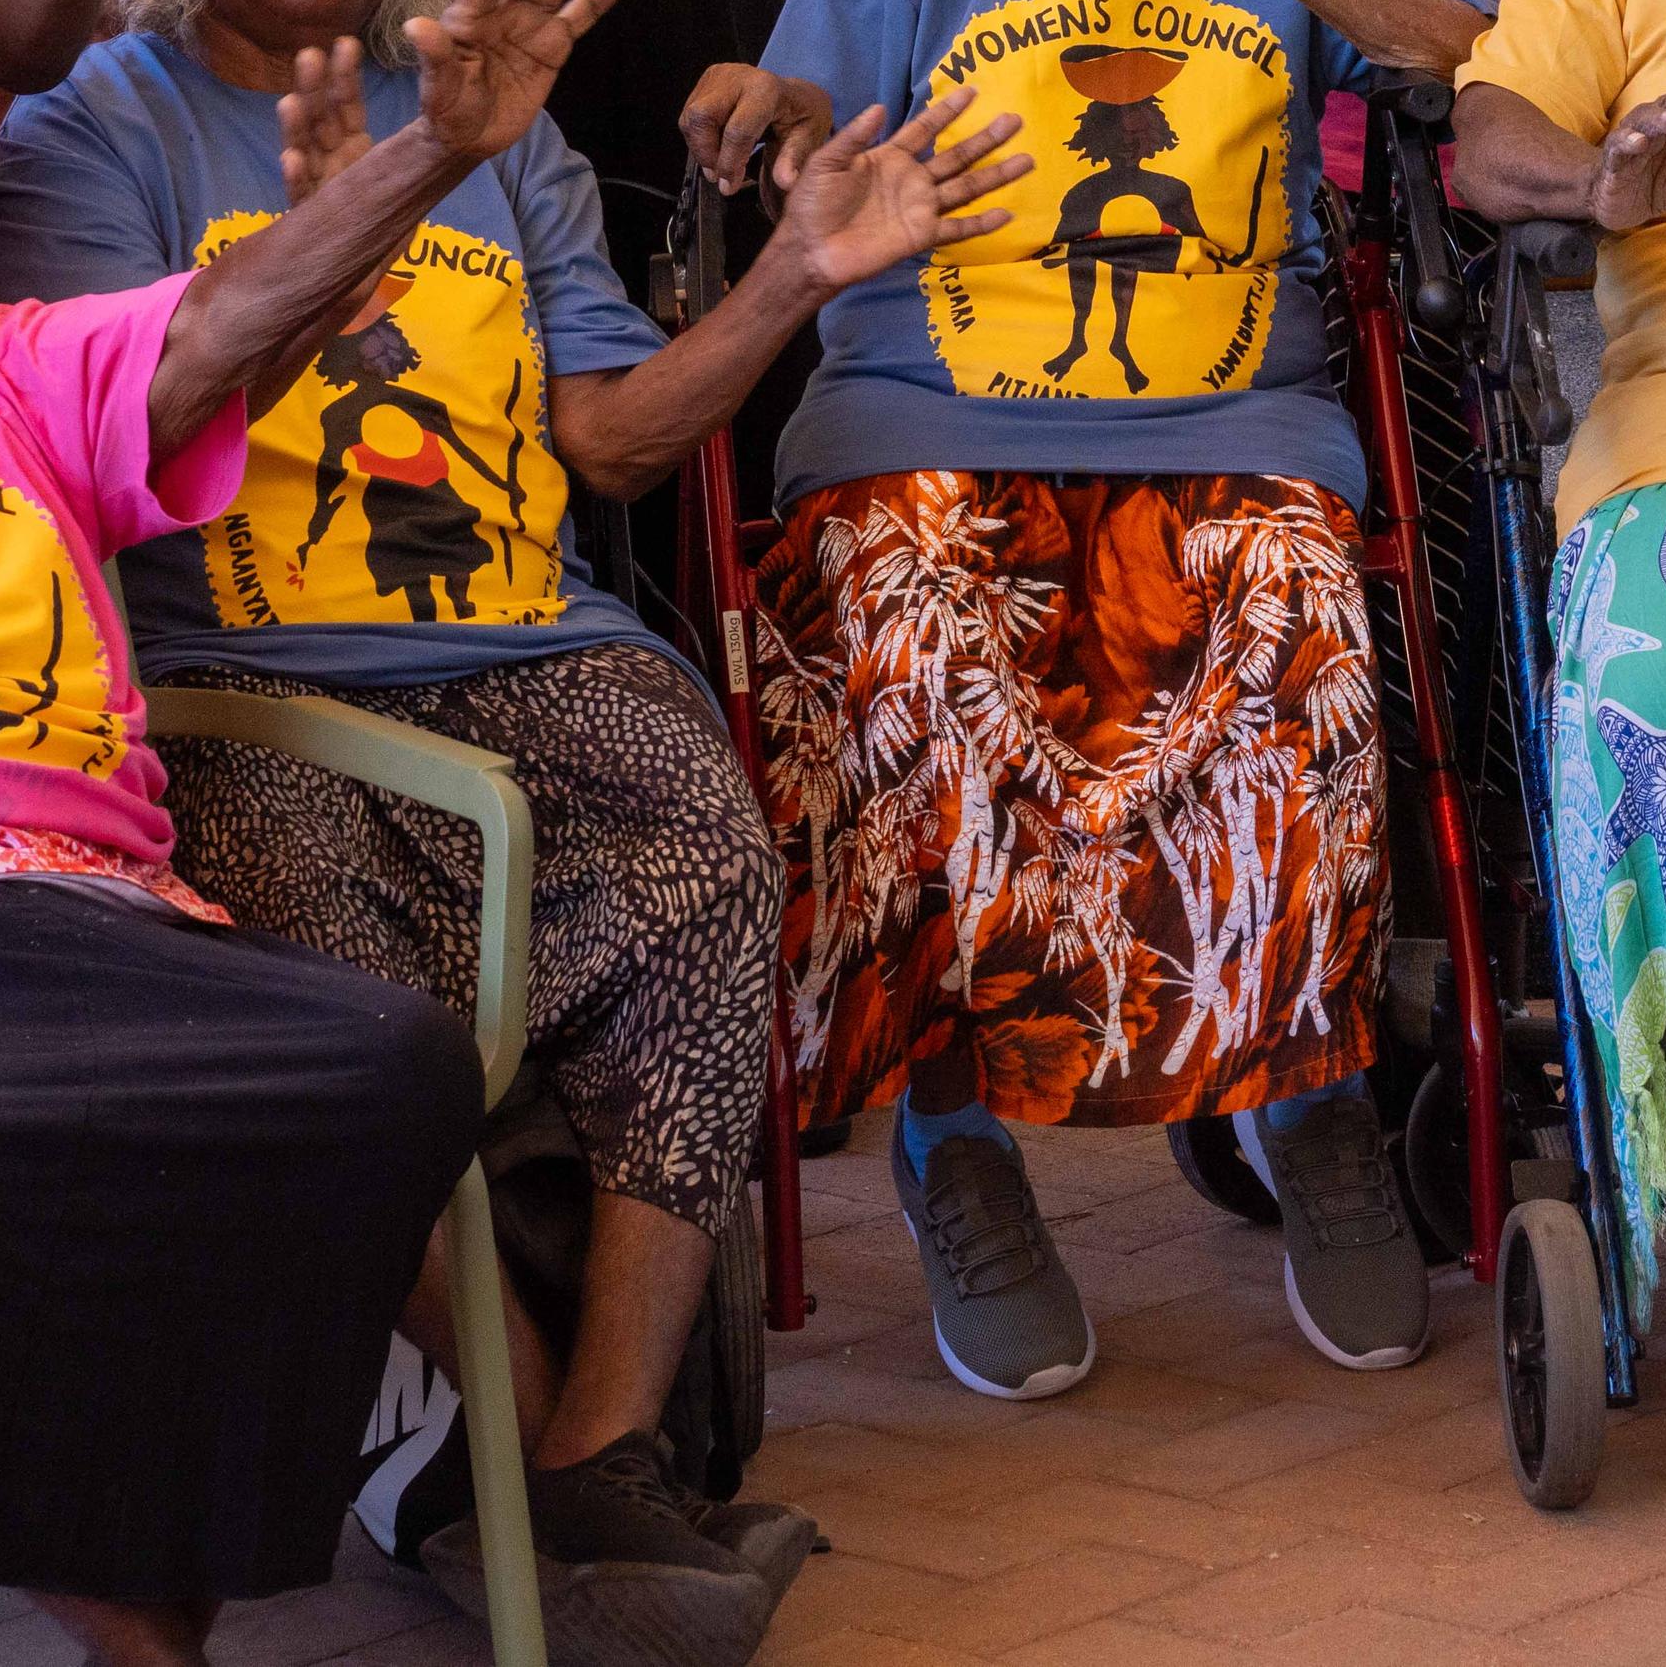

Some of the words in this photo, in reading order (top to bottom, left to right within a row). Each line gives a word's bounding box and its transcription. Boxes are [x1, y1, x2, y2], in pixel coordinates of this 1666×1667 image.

[1133, 0, 1275, 78] COUNCIL
[403, 238, 513, 287] UNCIL
[728, 616, 741, 654] 130kg
[732, 657, 745, 685] SWL
